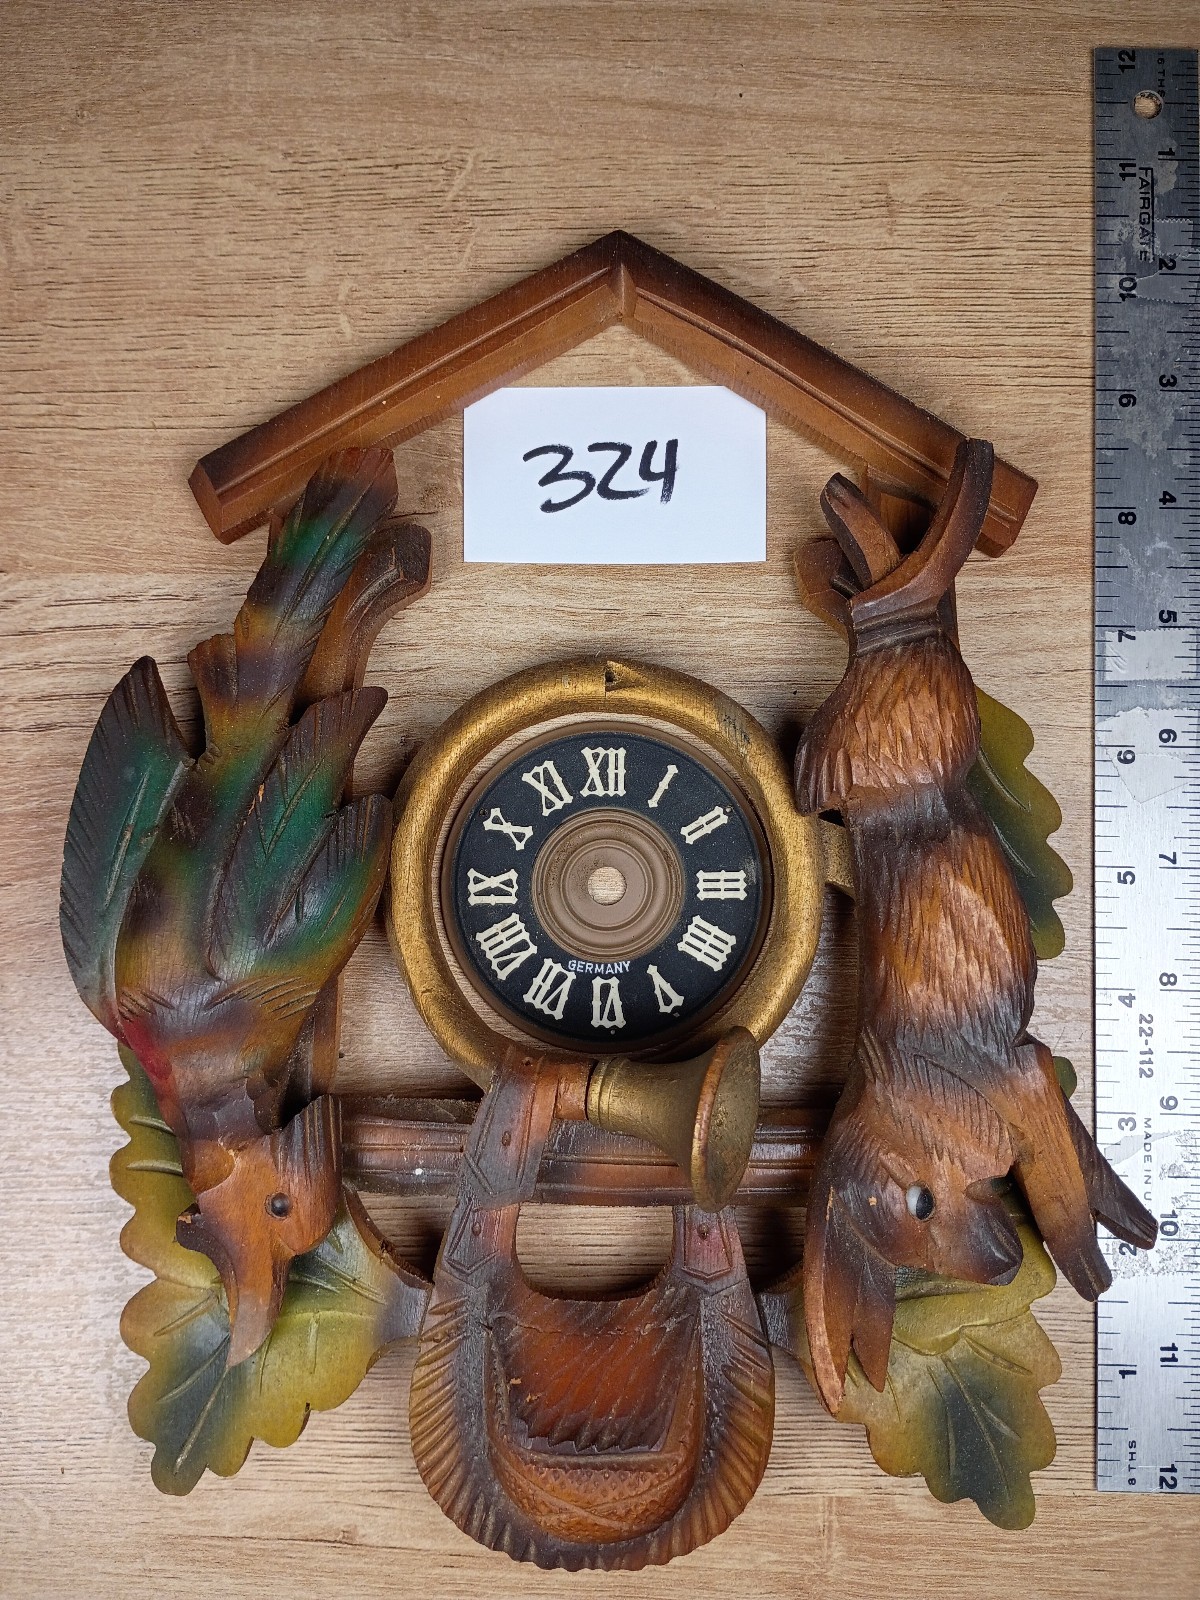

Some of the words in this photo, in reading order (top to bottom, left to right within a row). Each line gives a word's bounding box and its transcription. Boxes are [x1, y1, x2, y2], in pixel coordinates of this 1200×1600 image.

[1118, 50, 1135, 73] 12
[1158, 148, 1175, 156] 1
[1119, 163, 1136, 181] 11
[1139, 167, 1151, 262] FAIRGATE
[1159, 258, 1176, 270] 2
[1119, 277, 1137, 301] 10
[1159, 374, 1177, 388] 3
[1118, 393, 1136, 408] 9
[522, 438, 679, 513] 324
[1159, 491, 1177, 505] 4
[1118, 512, 1136, 525] 8
[1159, 610, 1177, 623] 5
[1118, 630, 1136, 642] 7
[1159, 728, 1177, 743] 6
[1117, 750, 1136, 764] 6
[580, 747, 627, 797] XII
[522, 760, 573, 817] XI
[648, 764, 679, 808] I
[483, 807, 534, 851] X
[680, 805, 729, 844] II
[1159, 852, 1177, 864] 7
[696, 869, 747, 901] III
[1117, 870, 1136, 885] 5
[466, 868, 519, 906] IX
[475, 912, 538, 980] VIII
[677, 914, 737, 972] IIII
[568, 960, 630, 975] GERMANY
[1159, 972, 1177, 986] 8
[523, 957, 576, 1021] VII
[647, 965, 684, 1014] V
[591, 976, 627, 1028] VI
[1118, 993, 1136, 1008] 4
[1139, 1013, 1154, 1079] 22-112
[1160, 1095, 1178, 1111] 9
[1118, 1117, 1136, 1132] 3
[1143, 1117, 1152, 1163] MADE
[1143, 1169, 1152, 1184] IN
[1160, 1209, 1179, 1236] 10
[1119, 1243, 1137, 1256] 2
[1160, 1343, 1178, 1362] 11
[1119, 1370, 1137, 1379] 1
[1160, 1463, 1178, 1490] 12
